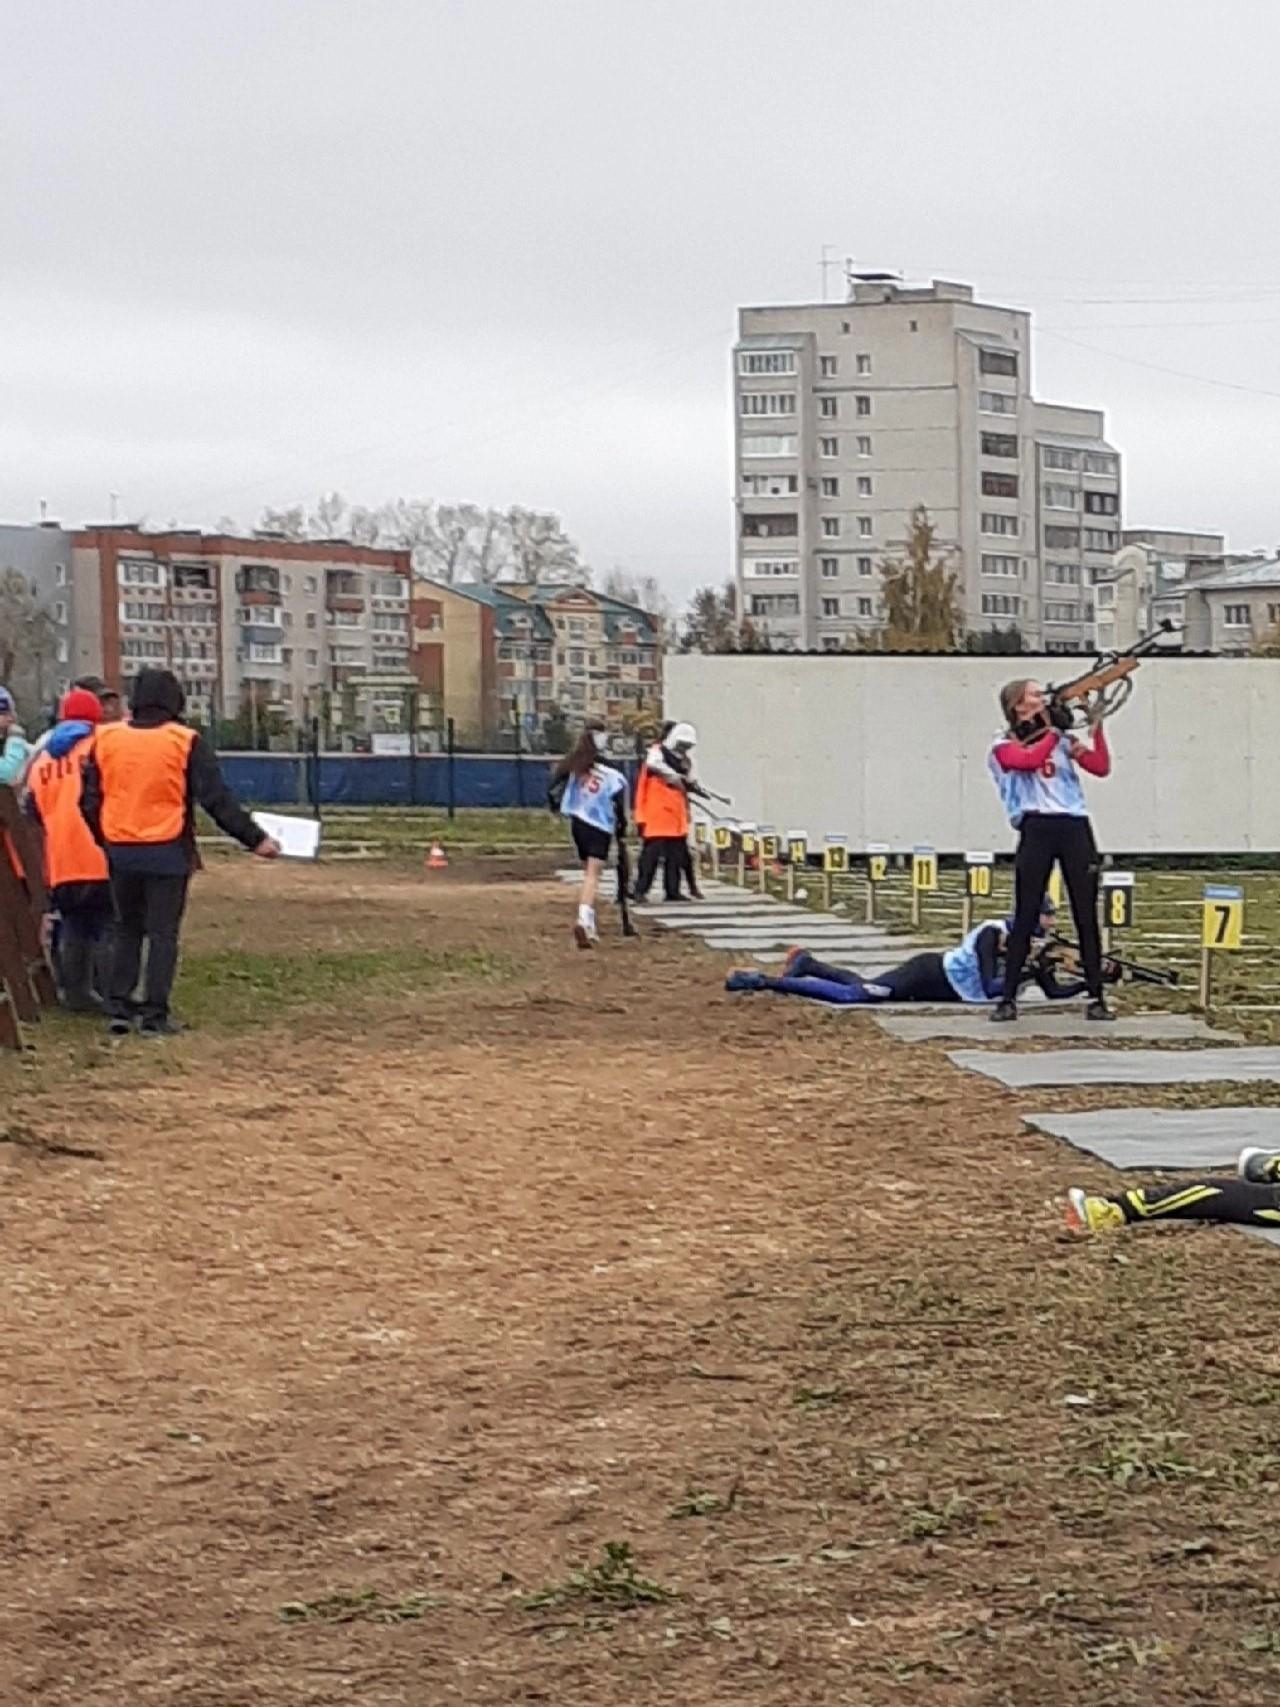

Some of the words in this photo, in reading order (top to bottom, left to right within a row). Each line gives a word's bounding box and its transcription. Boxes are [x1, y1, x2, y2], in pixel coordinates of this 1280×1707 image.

[917, 860, 931, 886] 11
[968, 865, 991, 895] 10
[1110, 888, 1126, 925] 8
[1214, 905, 1231, 944] 7
